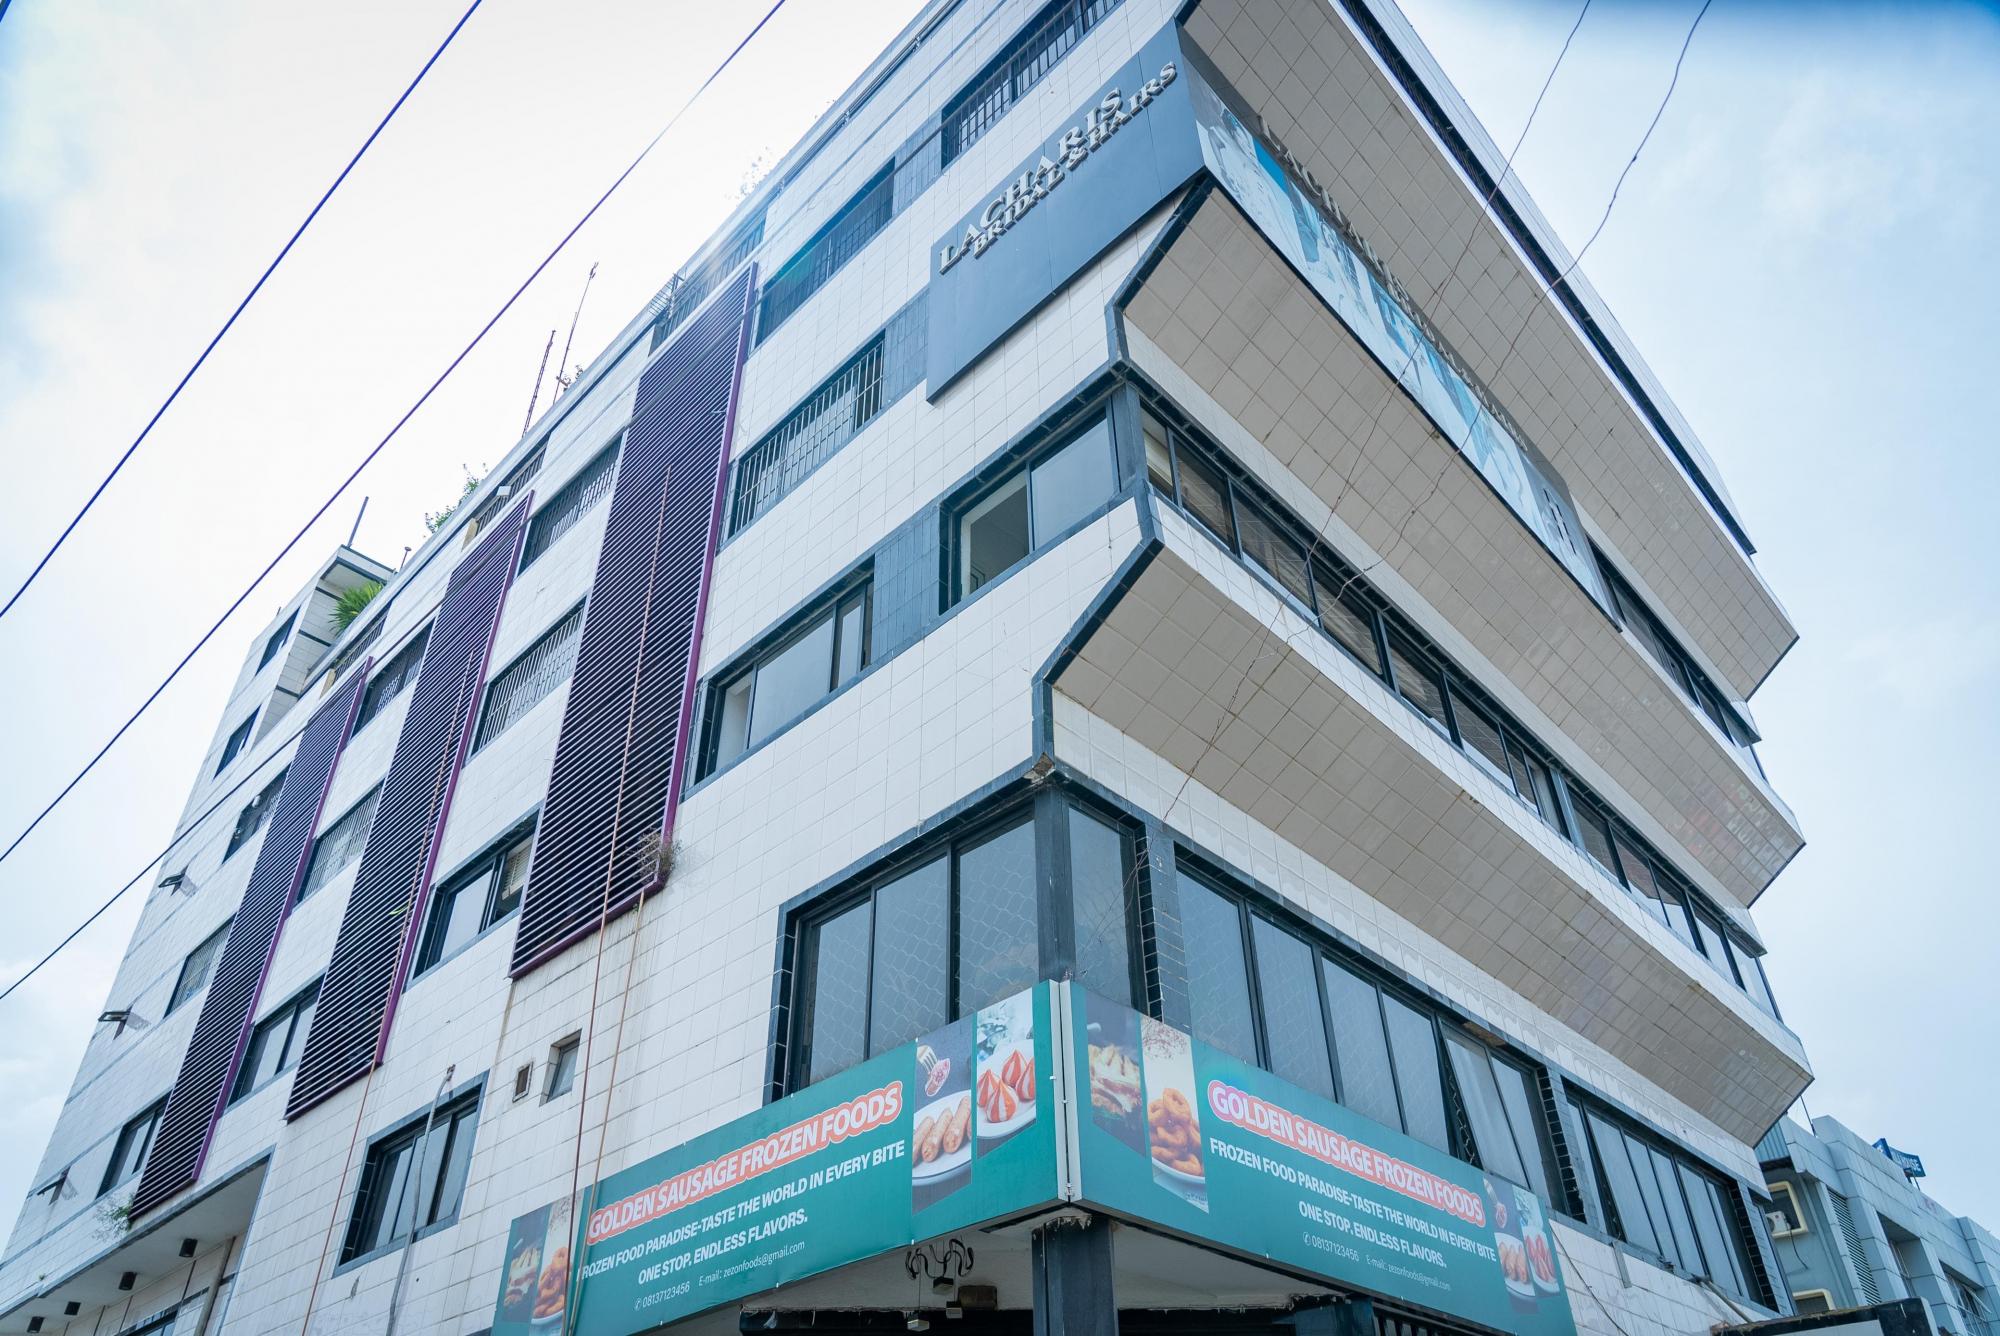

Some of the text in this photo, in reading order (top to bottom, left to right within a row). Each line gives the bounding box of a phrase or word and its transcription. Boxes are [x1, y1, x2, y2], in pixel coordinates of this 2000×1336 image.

[974, 61, 1177, 259] BRIDAL & HAIRS
[589, 1087, 899, 1239] GOLDEN SAUSAGE FROZEN FOODS
[615, 1244, 645, 1266] FOOD
[645, 1207, 735, 1255] PARADISE-TASTE
[737, 1194, 761, 1218] THE
[762, 1178, 807, 1208] WORLD
[810, 1171, 823, 1189] IN
[825, 1152, 871, 1184] EVERY
[872, 1140, 904, 1166] BITE
[1210, 1137, 1496, 1262] FROZEN FOOD PARADISE-TASTE THE WORLD IN EVERY BITE
[1213, 1087, 1483, 1221] GOLDEN SAUSAGE FROZEN FOODS
[638, 1208, 808, 1285] ONE STOP. ENDLESS FLAVORS.
[1299, 1201, 1447, 1268] ONE STOP. ENDLESS FLAVORS.
